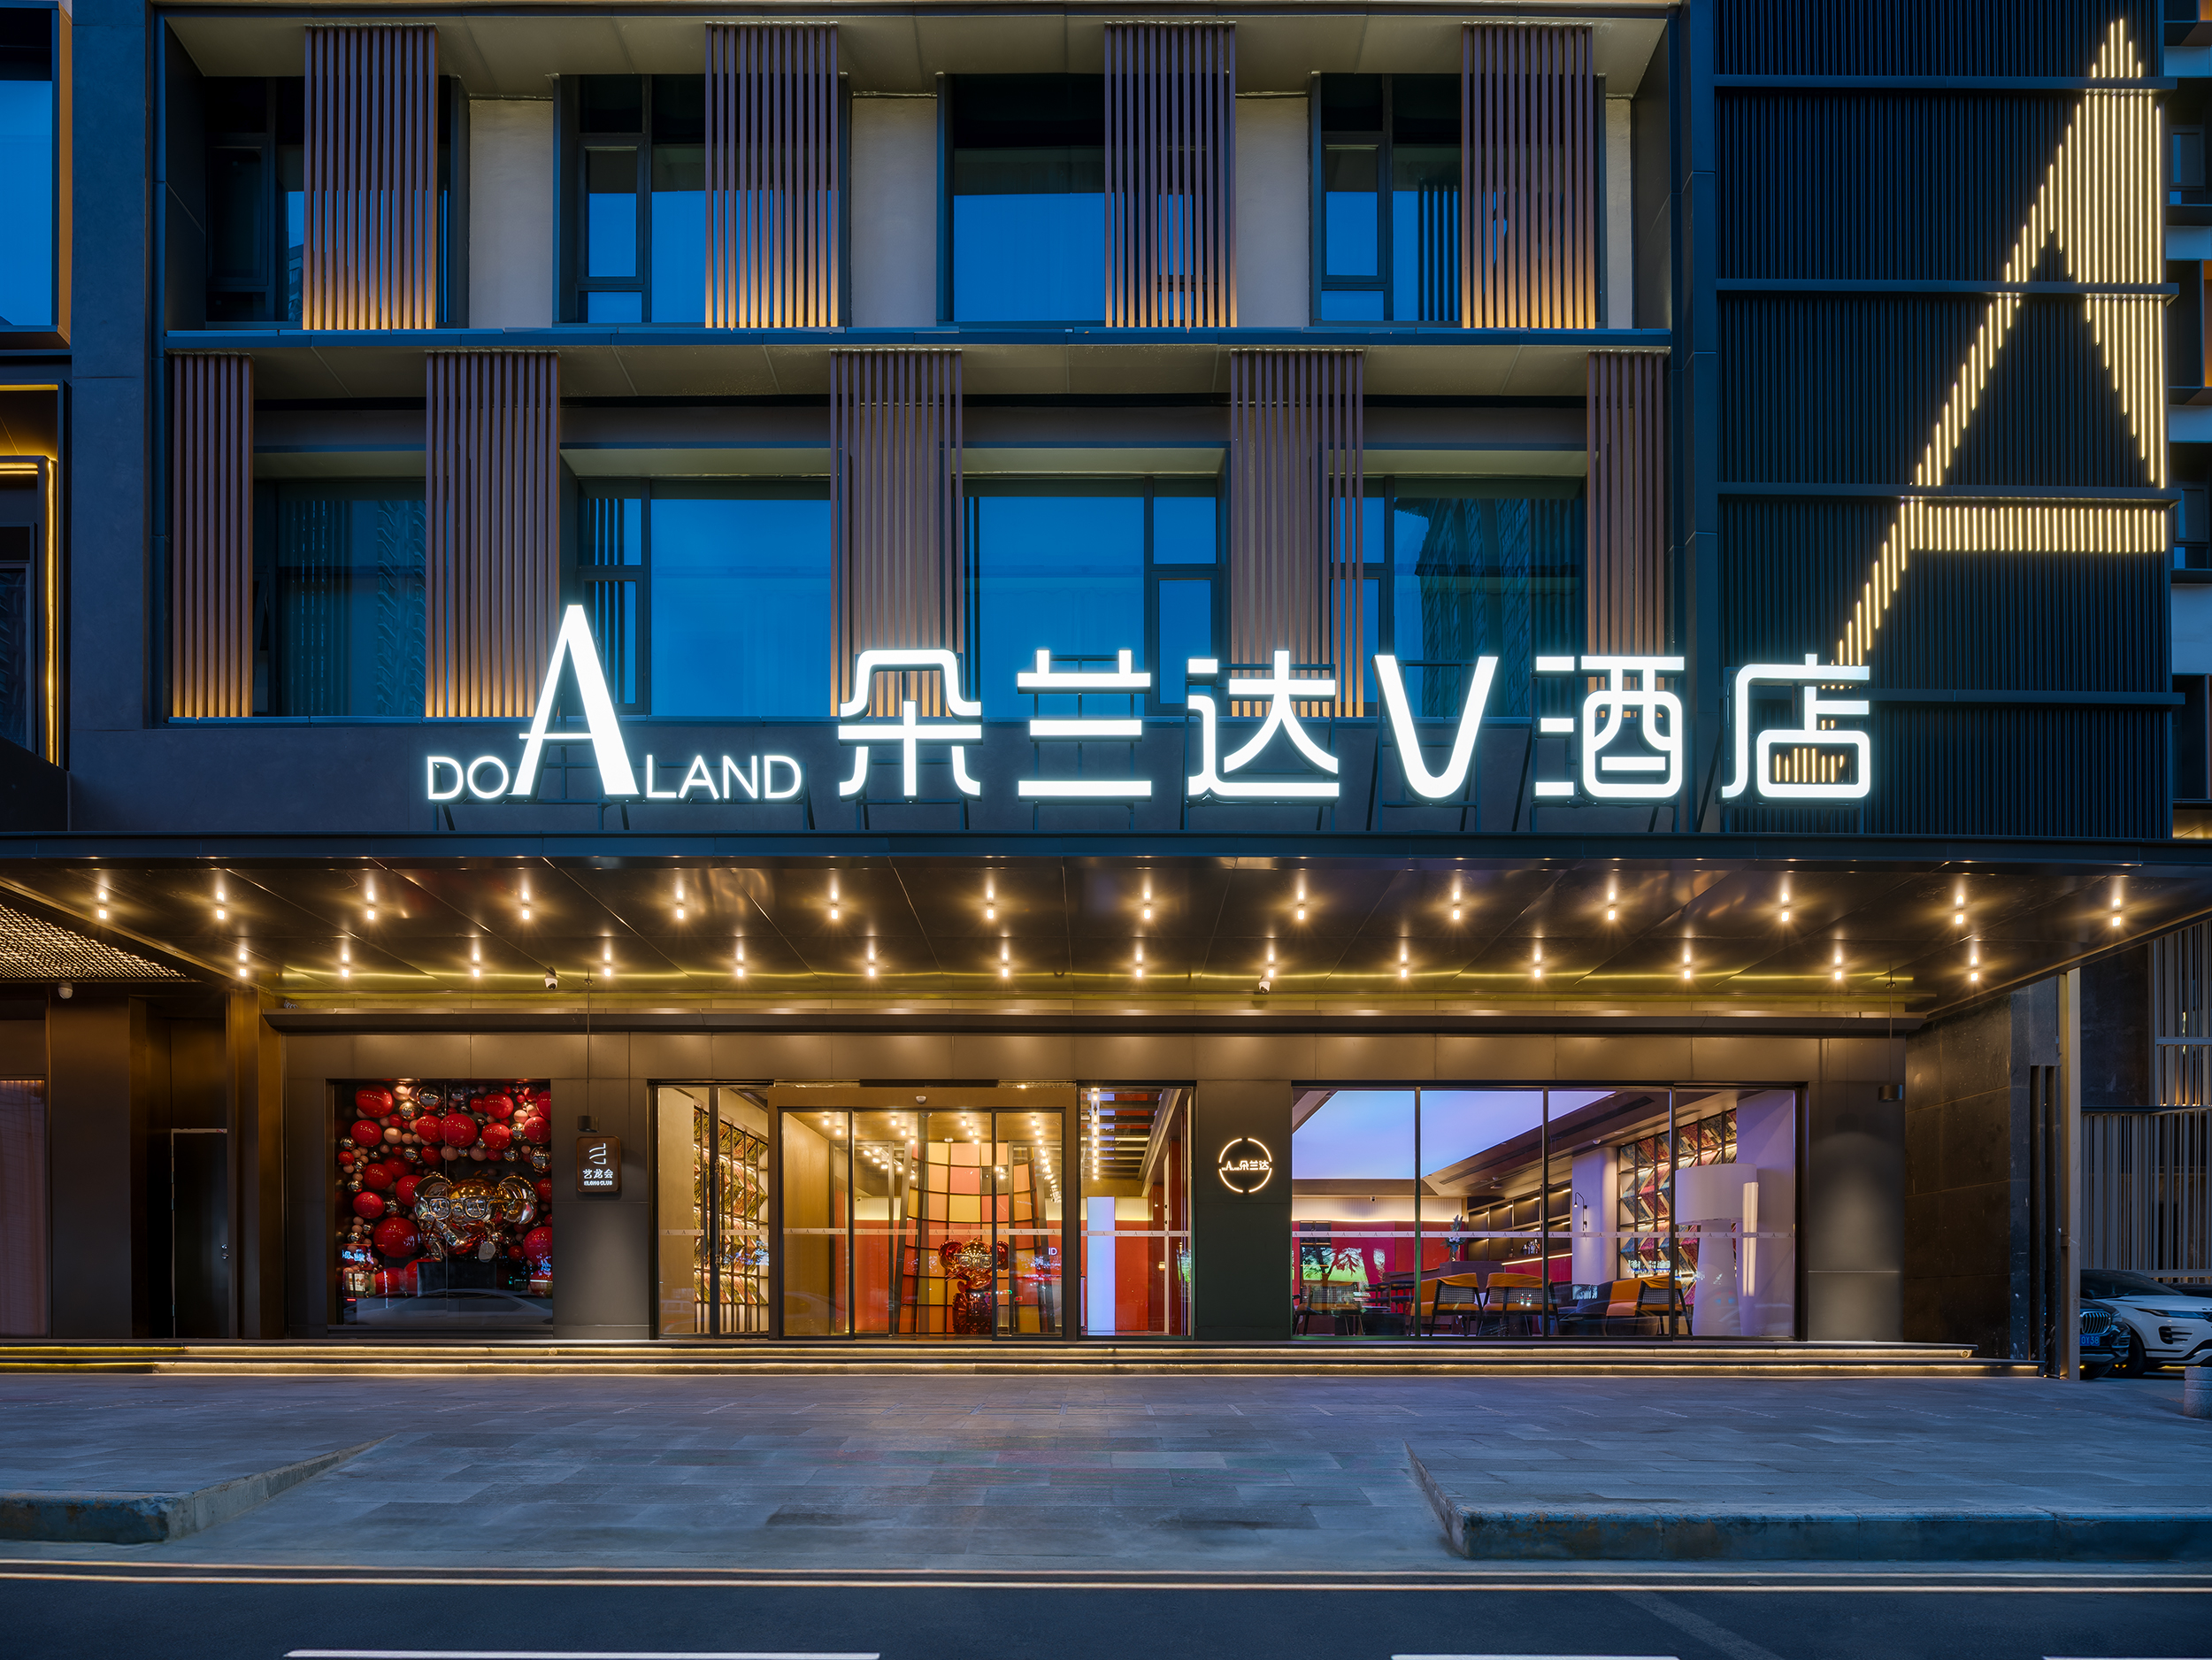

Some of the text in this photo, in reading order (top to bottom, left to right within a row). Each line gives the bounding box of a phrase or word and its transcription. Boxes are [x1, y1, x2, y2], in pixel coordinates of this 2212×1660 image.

[1240, 1159, 1270, 1171] 朵兰达
[582, 1168, 614, 1180] 艺龙会
